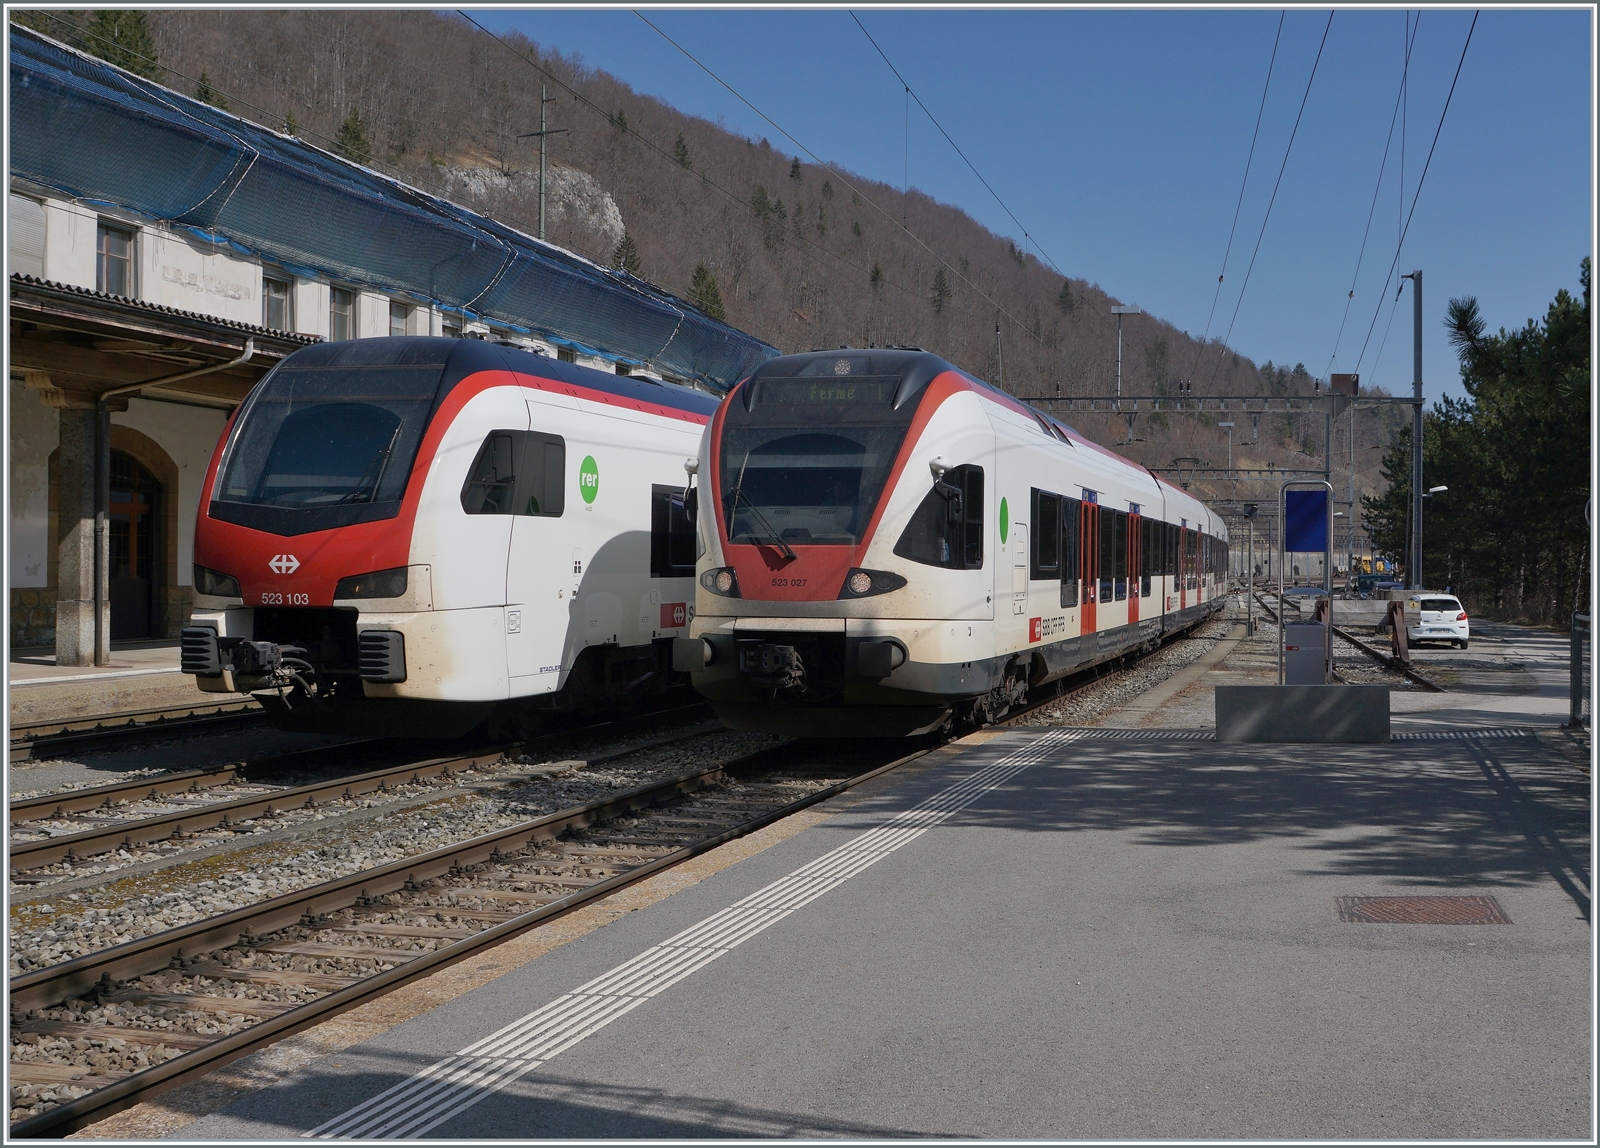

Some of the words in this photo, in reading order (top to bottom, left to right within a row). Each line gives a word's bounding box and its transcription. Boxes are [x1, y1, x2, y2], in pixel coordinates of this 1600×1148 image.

[581, 472, 598, 488] rer
[771, 578, 788, 587] 523
[790, 578, 808, 587] 027
[261, 592, 283, 605] 523
[286, 592, 309, 605] 103
[1042, 618, 1050, 637] SBB
[1058, 615, 1066, 634] FFS
[539, 664, 562, 673] STADLER
